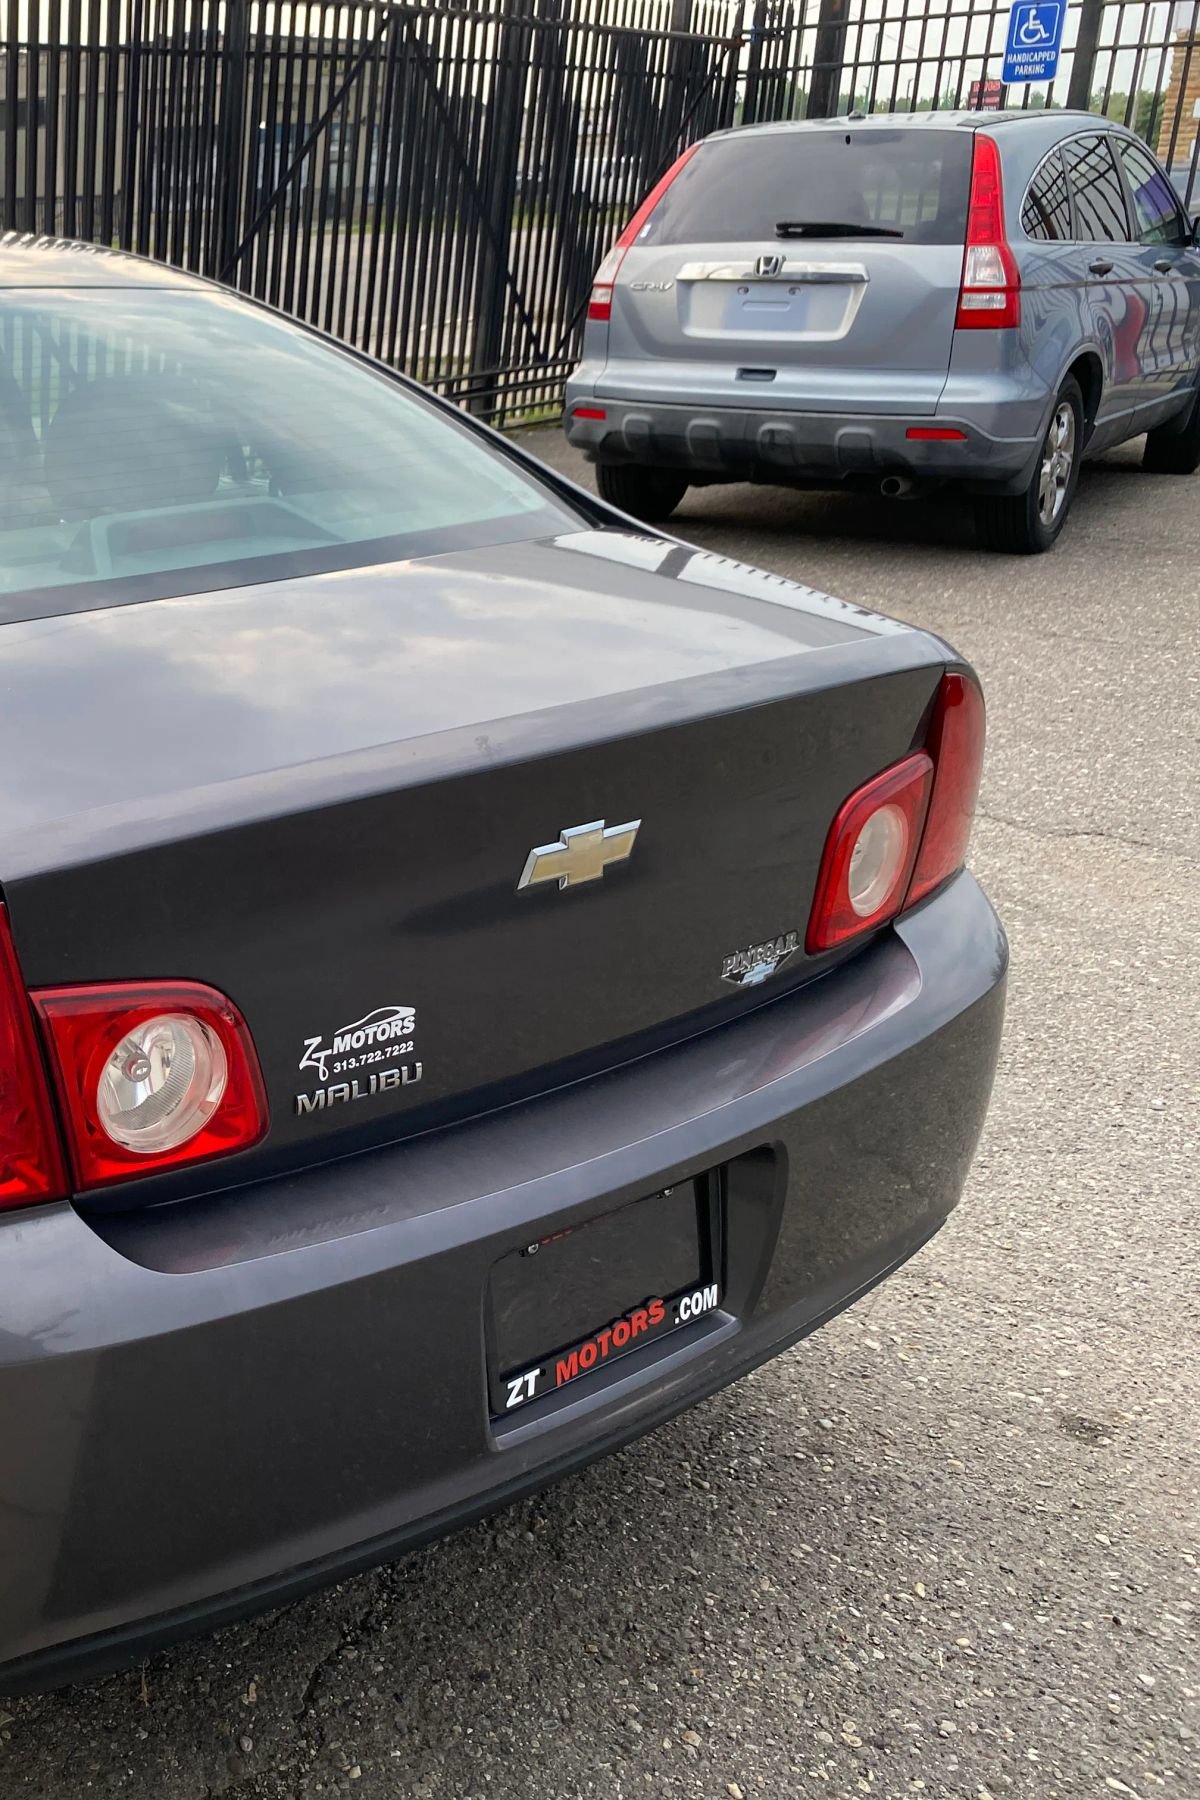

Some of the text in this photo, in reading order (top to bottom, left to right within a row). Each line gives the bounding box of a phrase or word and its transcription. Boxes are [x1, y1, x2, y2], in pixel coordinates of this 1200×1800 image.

[1007, 51, 1056, 63] HANDICAPPED
[1014, 64, 1045, 75] PARKING
[629, 281, 675, 291] CR-V
[332, 1016, 416, 1055] MOTORS
[333, 1041, 414, 1073] 313.722.7222
[296, 1062, 423, 1116] MALIBU
[506, 1284, 719, 1409] ZT MOTORS .COM
